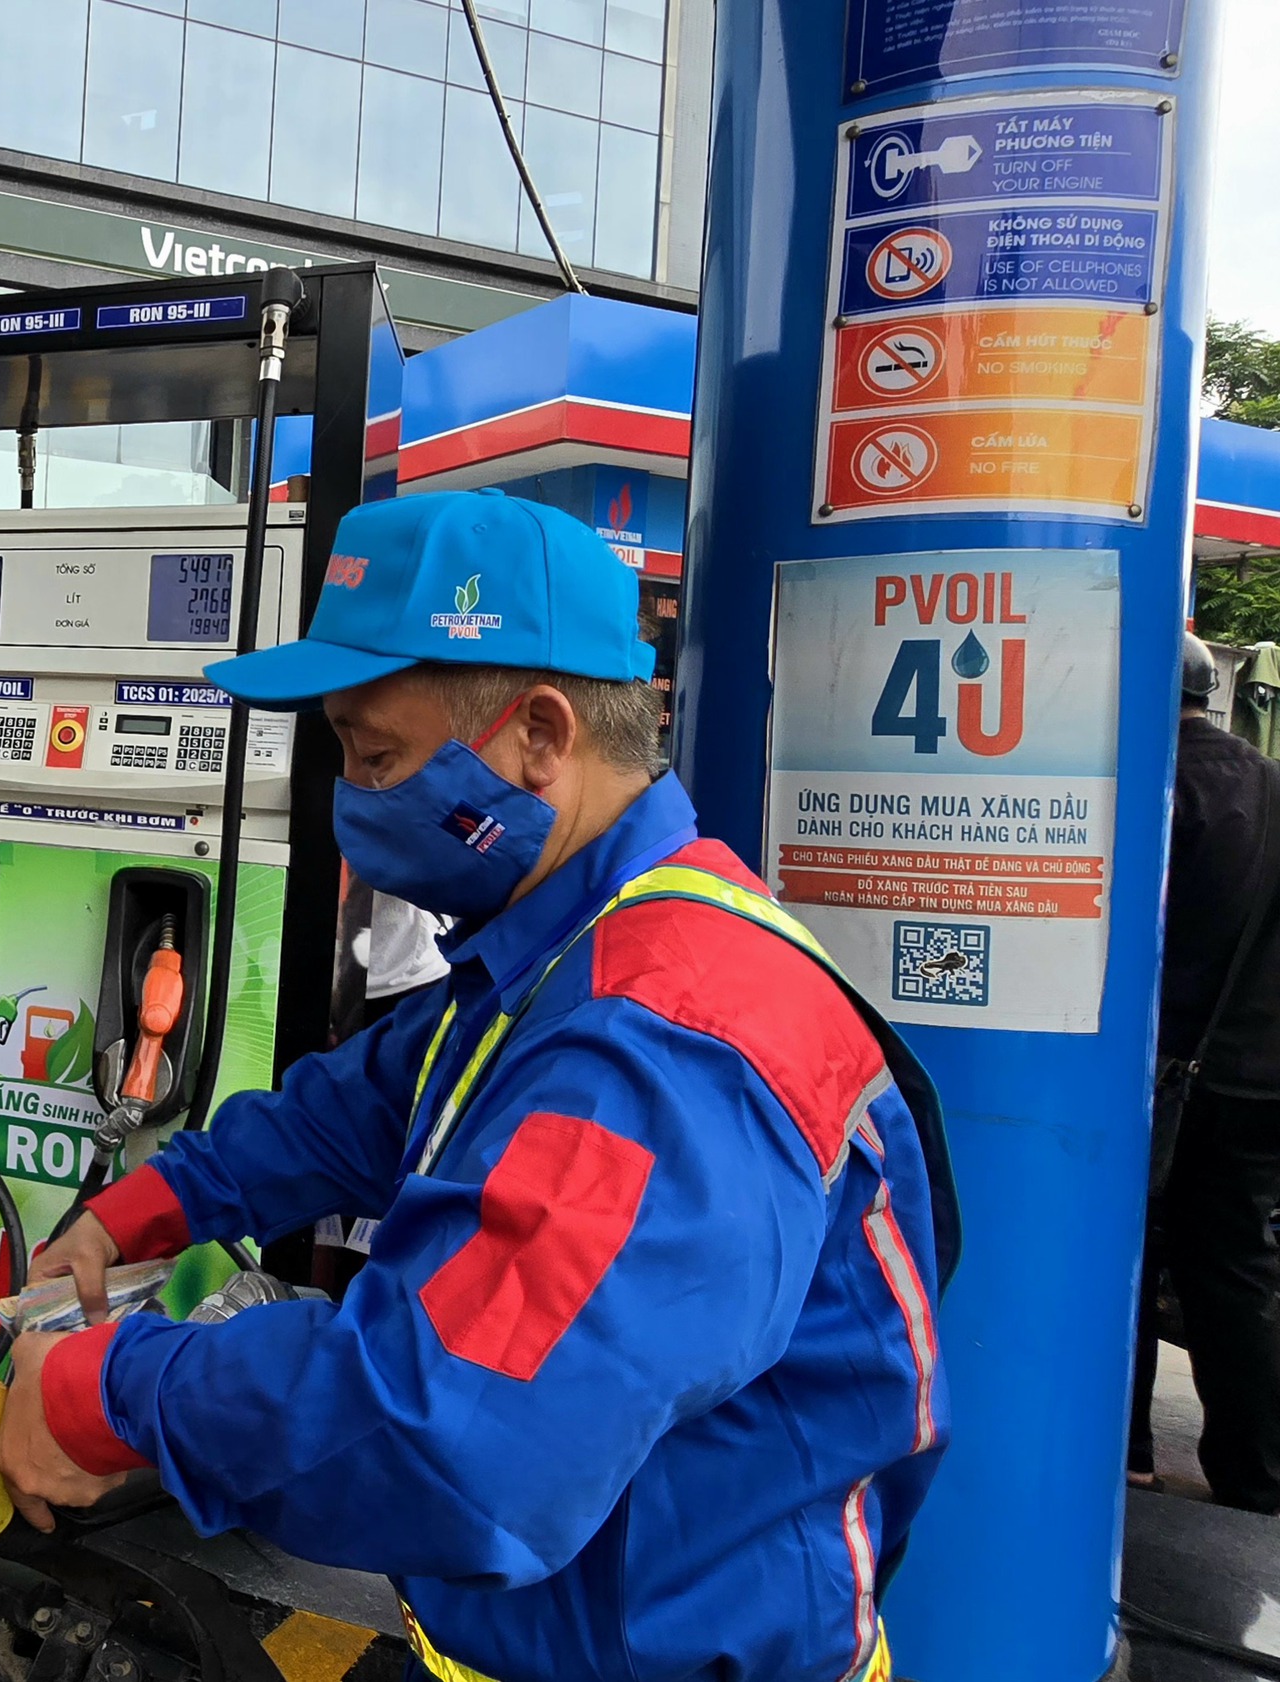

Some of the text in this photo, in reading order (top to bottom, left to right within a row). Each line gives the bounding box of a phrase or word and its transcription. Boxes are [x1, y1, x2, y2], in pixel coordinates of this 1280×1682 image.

[996, 115, 1073, 134] TẮT MÁY
[995, 132, 1112, 151] PHƯƠNG TIỆN
[993, 159, 1072, 175] TURN OFF
[993, 177, 1103, 192] YOUR ENGINE
[989, 214, 1123, 232] KHÔNG SỬ DỤNG
[987, 233, 1145, 250] ĐIỆN THOẠI DI ĐỘNG
[985, 260, 1142, 277] USE OF CELLPHONES
[983, 278, 1118, 293] IS NOT ALLOWED
[130, 302, 211, 323] RON 95-III
[25, 313, 65, 330] 95-III
[979, 331, 1113, 350] CẤM HÚT THUỐC
[977, 362, 1087, 375] NO SMOKING
[971, 432, 1014, 448] CẤM
[970, 462, 1040, 474] NO FIRE
[66, 592, 81, 604] LÍT
[875, 572, 1026, 626] PVOIL
[75, 617, 90, 628] GIÁ
[190, 618, 228, 635] 19840
[432, 615, 501, 627] PETROVIETNAM
[450, 627, 480, 638] PVOIL
[122, 686, 155, 701] TCCS
[158, 687, 179, 702] 01:
[798, 788, 1088, 821] ỨNG DỤNG MUA XĂNG DẦU
[46, 807, 99, 821] TRƯỚC
[103, 812, 132, 823] KHI
[137, 815, 176, 827] BƠM
[797, 817, 1088, 845] DÀNH CHO KHÁCH HÀNG CÁ NHÂN
[792, 850, 813, 862] CHO
[847, 850, 879, 866] PHIẾU
[943, 857, 971, 872] THẬT
[992, 857, 1022, 873] DÀNG
[1025, 858, 1040, 873] VÀ
[1042, 858, 1063, 874] CHỦ
[1065, 860, 1091, 875] ĐỘNG
[912, 879, 950, 894] TRƯỚC
[952, 881, 974, 896] TRẢ
[1005, 885, 1028, 898] SAU
[824, 890, 854, 903] NGÂN
[857, 890, 889, 906] HÀNG
[893, 892, 916, 908] CẤP
[919, 893, 937, 908] TÍN
[941, 897, 972, 913] DỤNG
[976, 898, 1002, 912] MUA
[42, 1103, 78, 1122] SINH
